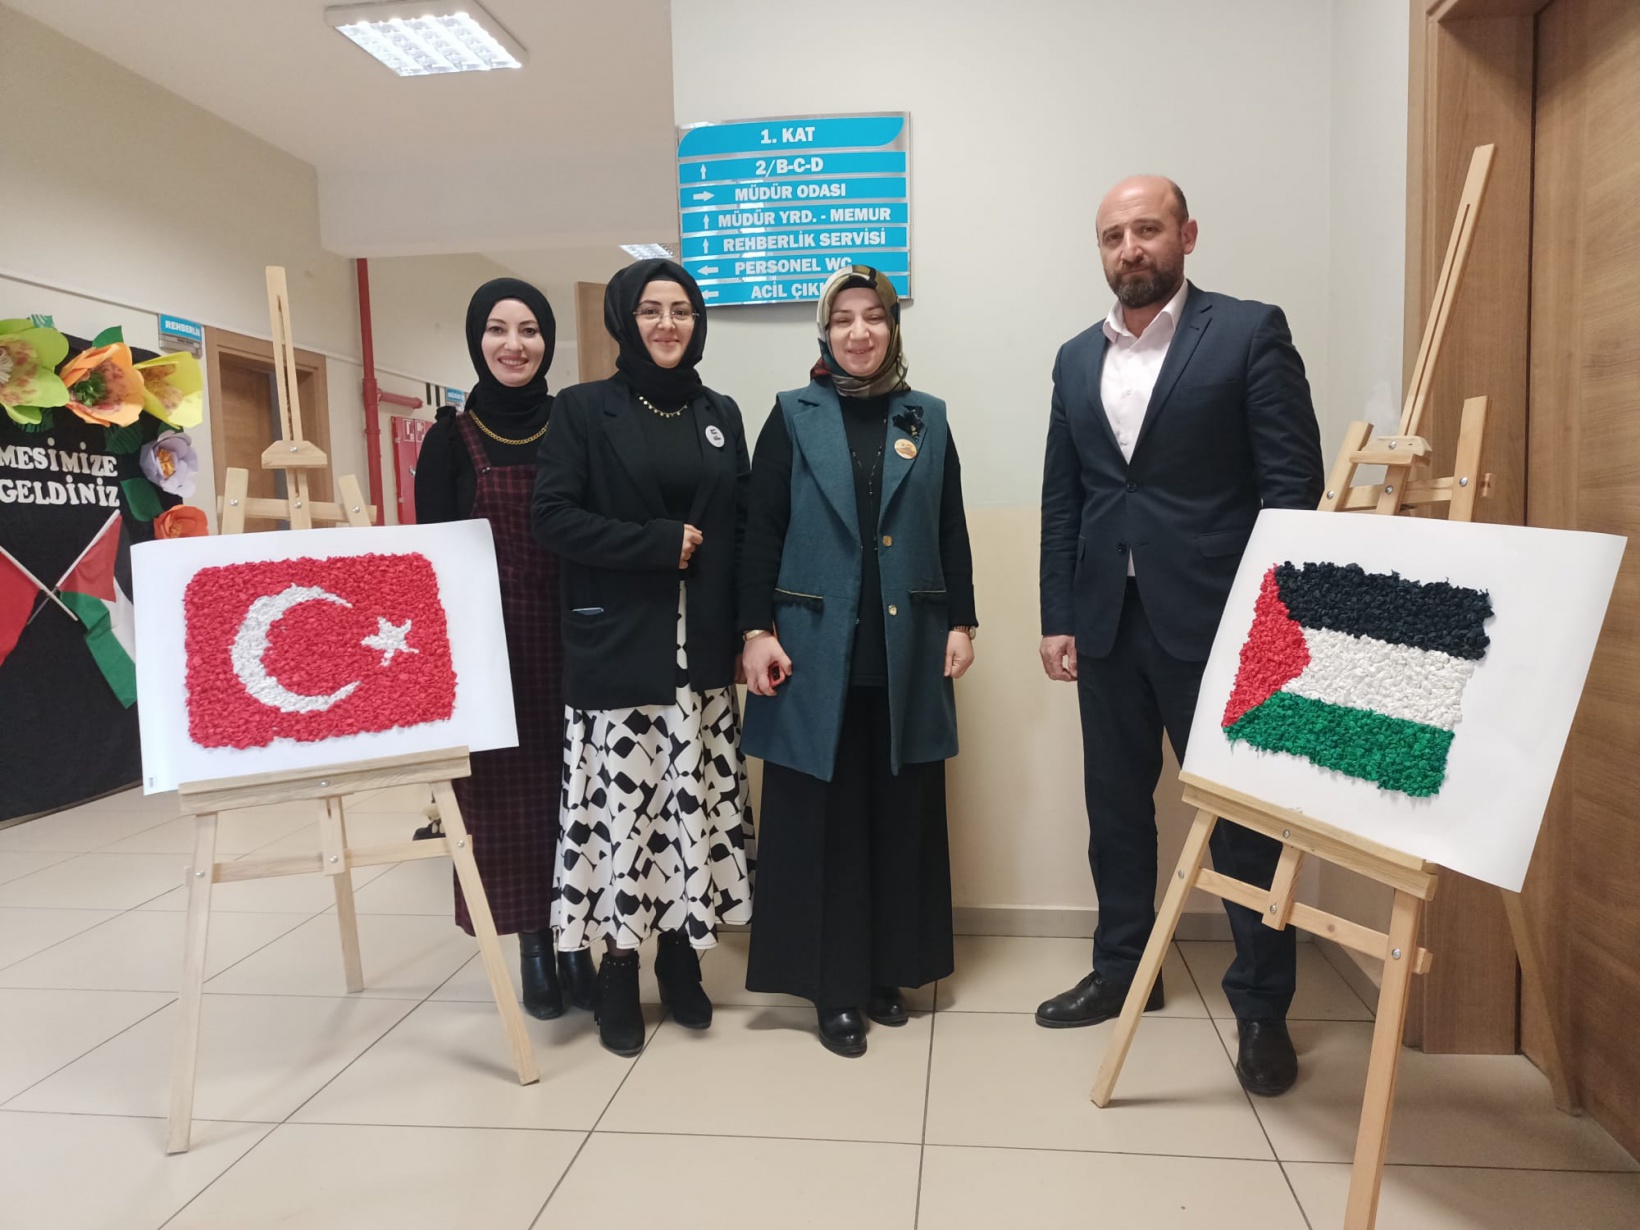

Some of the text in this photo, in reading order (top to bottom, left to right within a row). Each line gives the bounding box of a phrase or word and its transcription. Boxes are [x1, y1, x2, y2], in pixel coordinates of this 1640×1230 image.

[760, 126, 816, 144] 1. KAT
[755, 157, 824, 177] 2/B-C-D
[735, 183, 846, 201] MÜDÜR ODASI
[718, 210, 775, 227] MÜDÜR
[779, 210, 817, 224] YRD.
[830, 208, 891, 222] MEMUR
[723, 228, 886, 252] REHBERLİK SERVİSİ
[735, 256, 852, 275] PERSONEL WC
[751, 280, 787, 299] ACİL
[0, 437, 118, 477] MESİMİZE
[0, 474, 120, 507] GELDİNİZ
